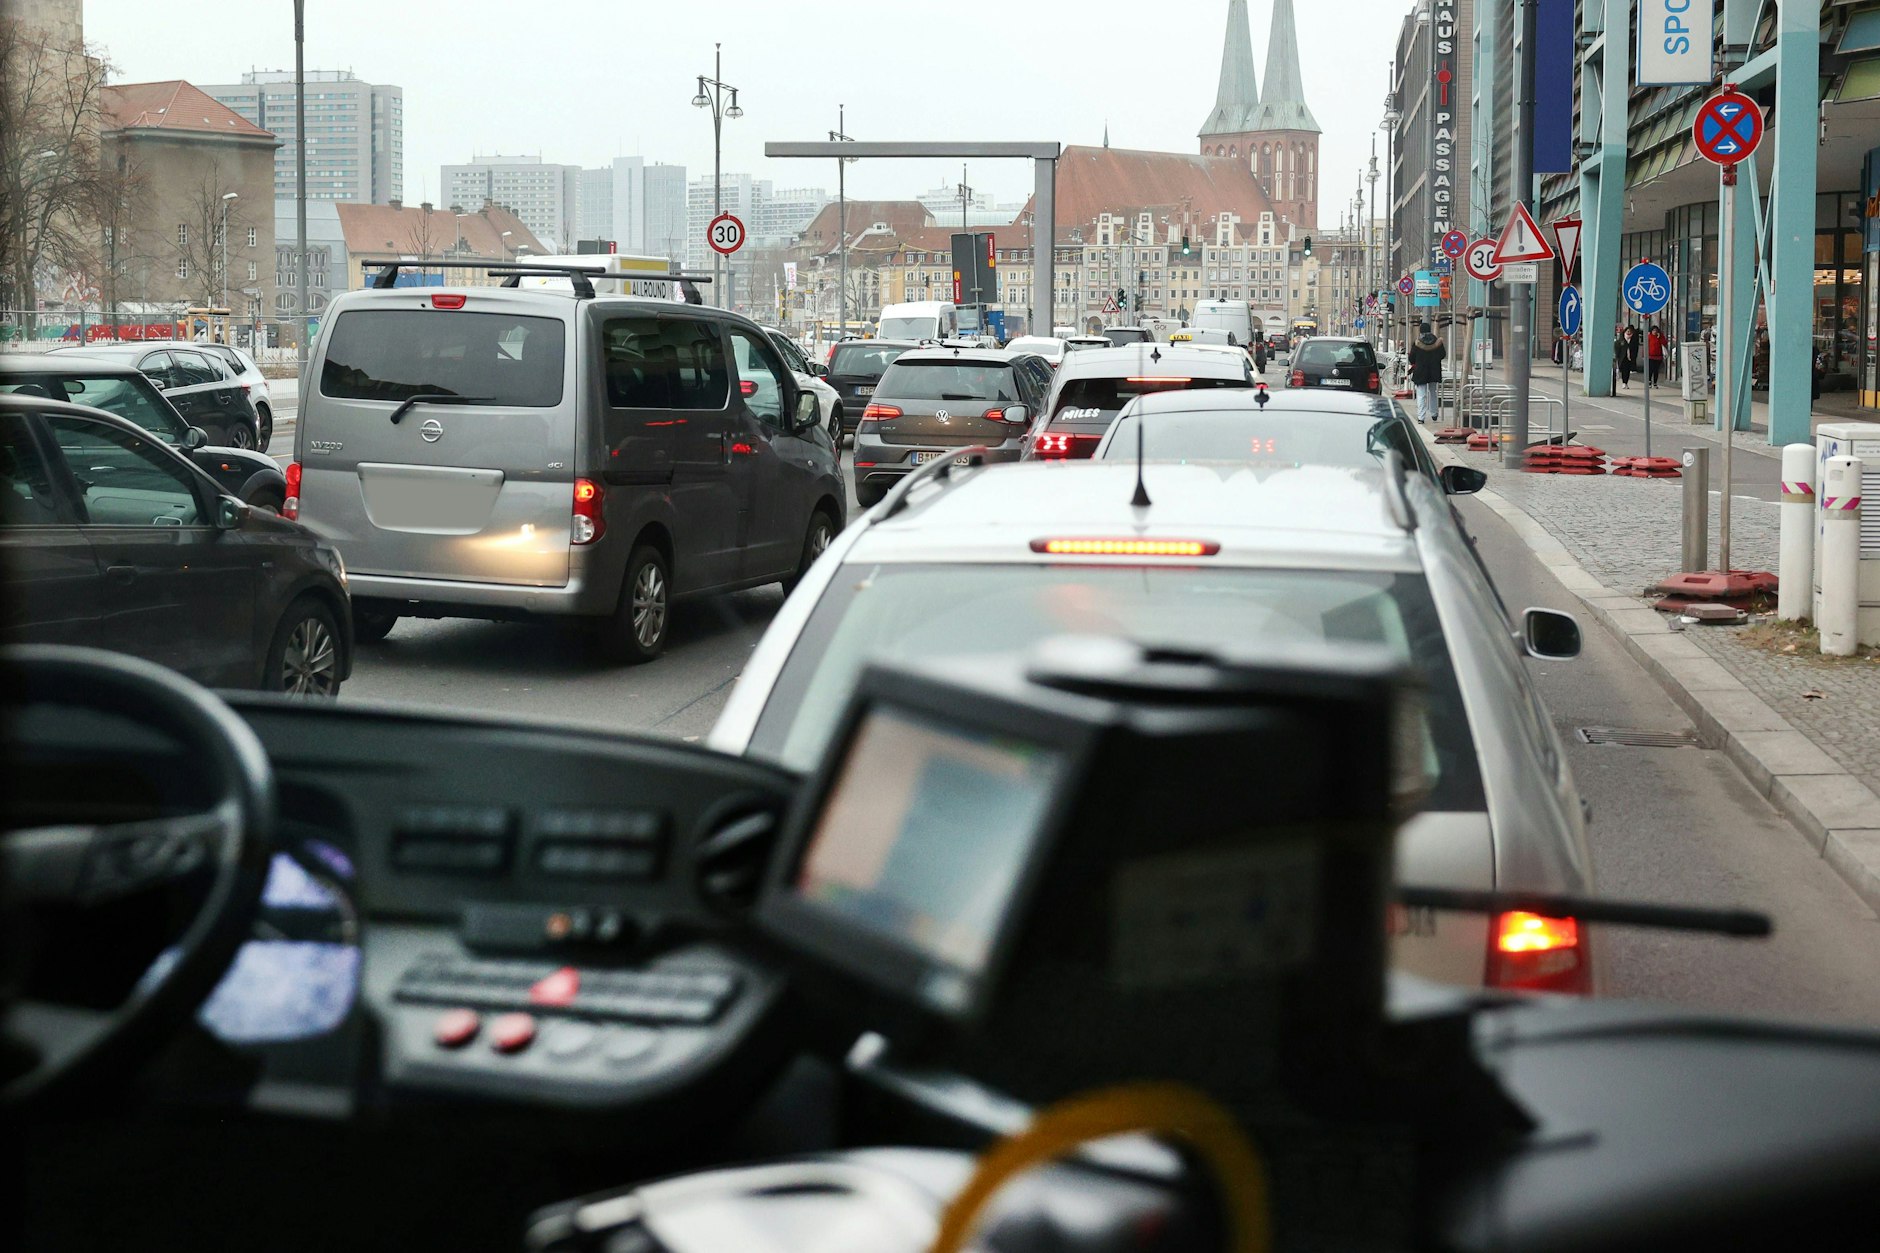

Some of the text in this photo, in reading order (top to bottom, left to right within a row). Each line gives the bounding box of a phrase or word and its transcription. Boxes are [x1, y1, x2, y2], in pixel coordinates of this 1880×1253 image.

[1434, 112, 1451, 233] PASSAGEN
[715, 225, 738, 244] 30
[1473, 250, 1497, 269] 30
[632, 280, 667, 299] ALLROUND
[1061, 408, 1100, 420] MILES
[311, 440, 343, 450] NV200
